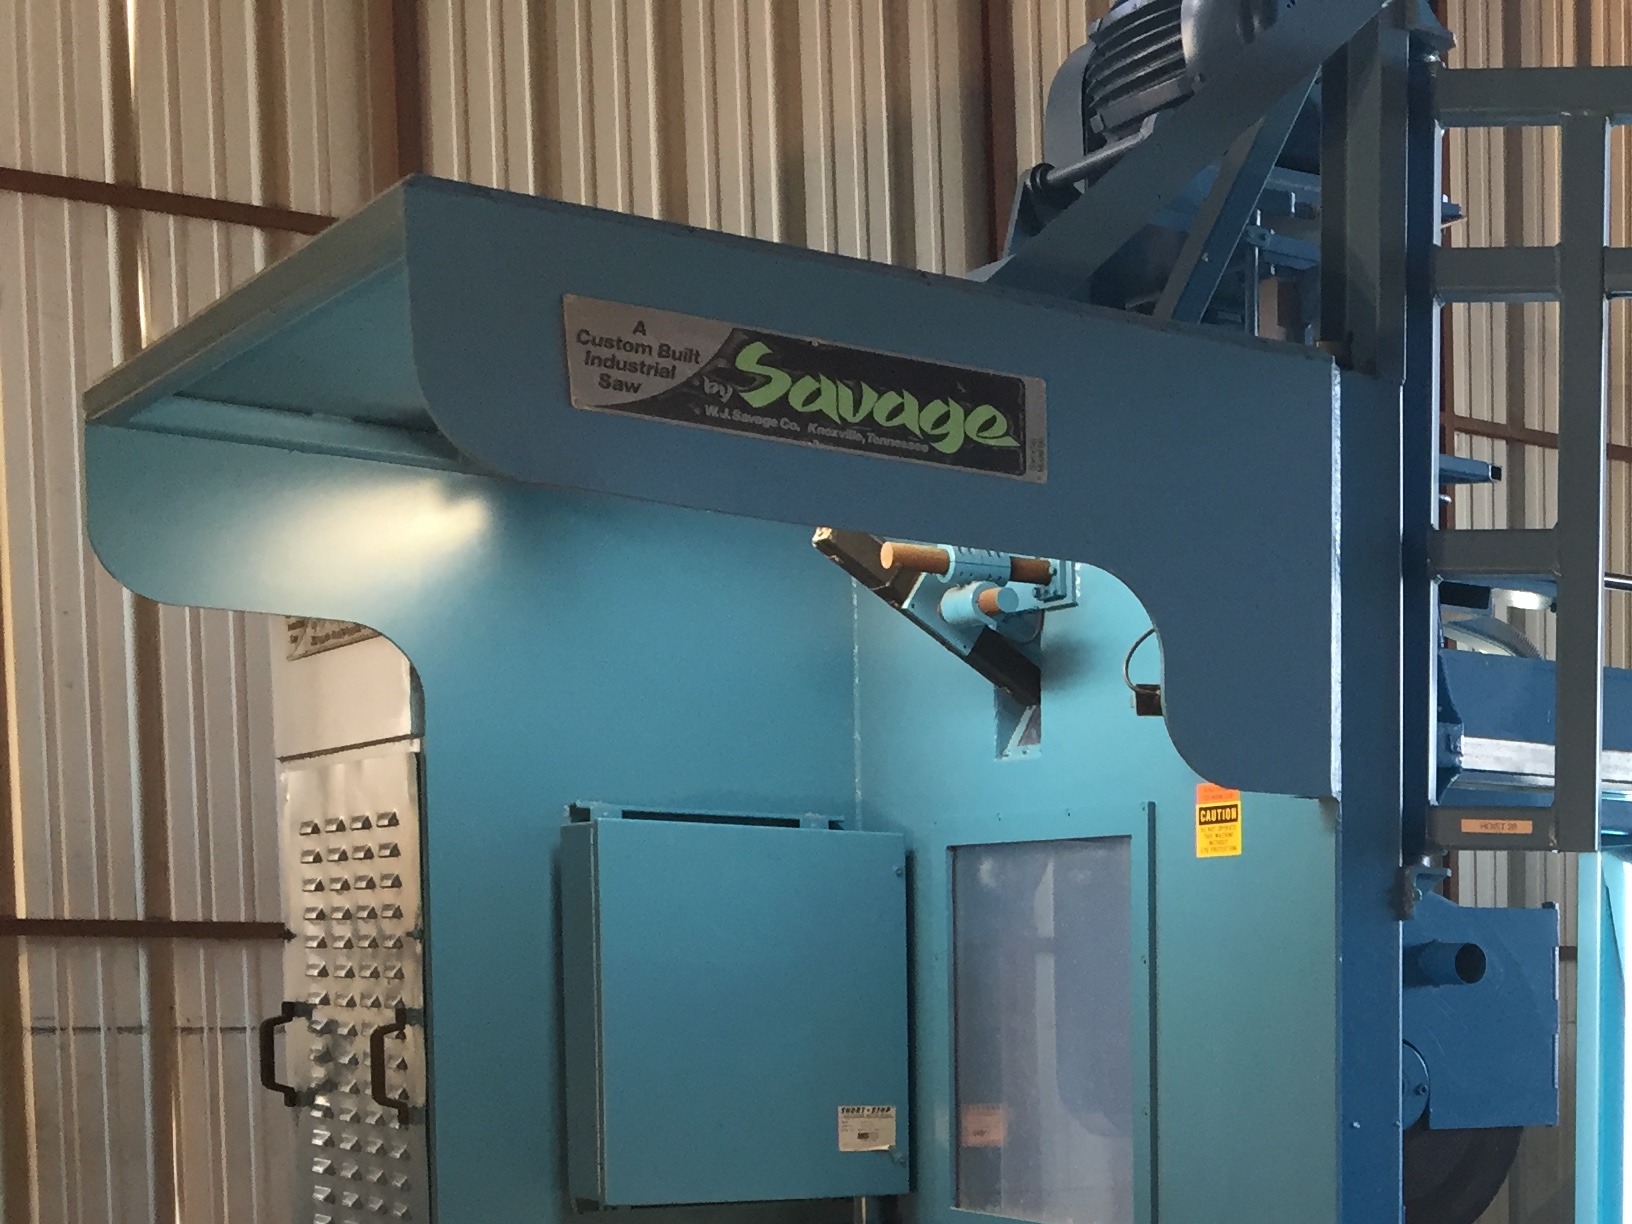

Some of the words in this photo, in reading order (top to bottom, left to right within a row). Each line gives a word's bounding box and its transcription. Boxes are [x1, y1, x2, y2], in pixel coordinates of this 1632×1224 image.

[632, 320, 647, 336] A
[576, 328, 653, 356] Custom
[657, 342, 700, 364] Built
[584, 350, 677, 380] Industrial
[598, 372, 642, 394] Saw
[703, 375, 734, 404] by
[735, 341, 1020, 454] Savage
[1200, 807, 1237, 823] CAUTION
